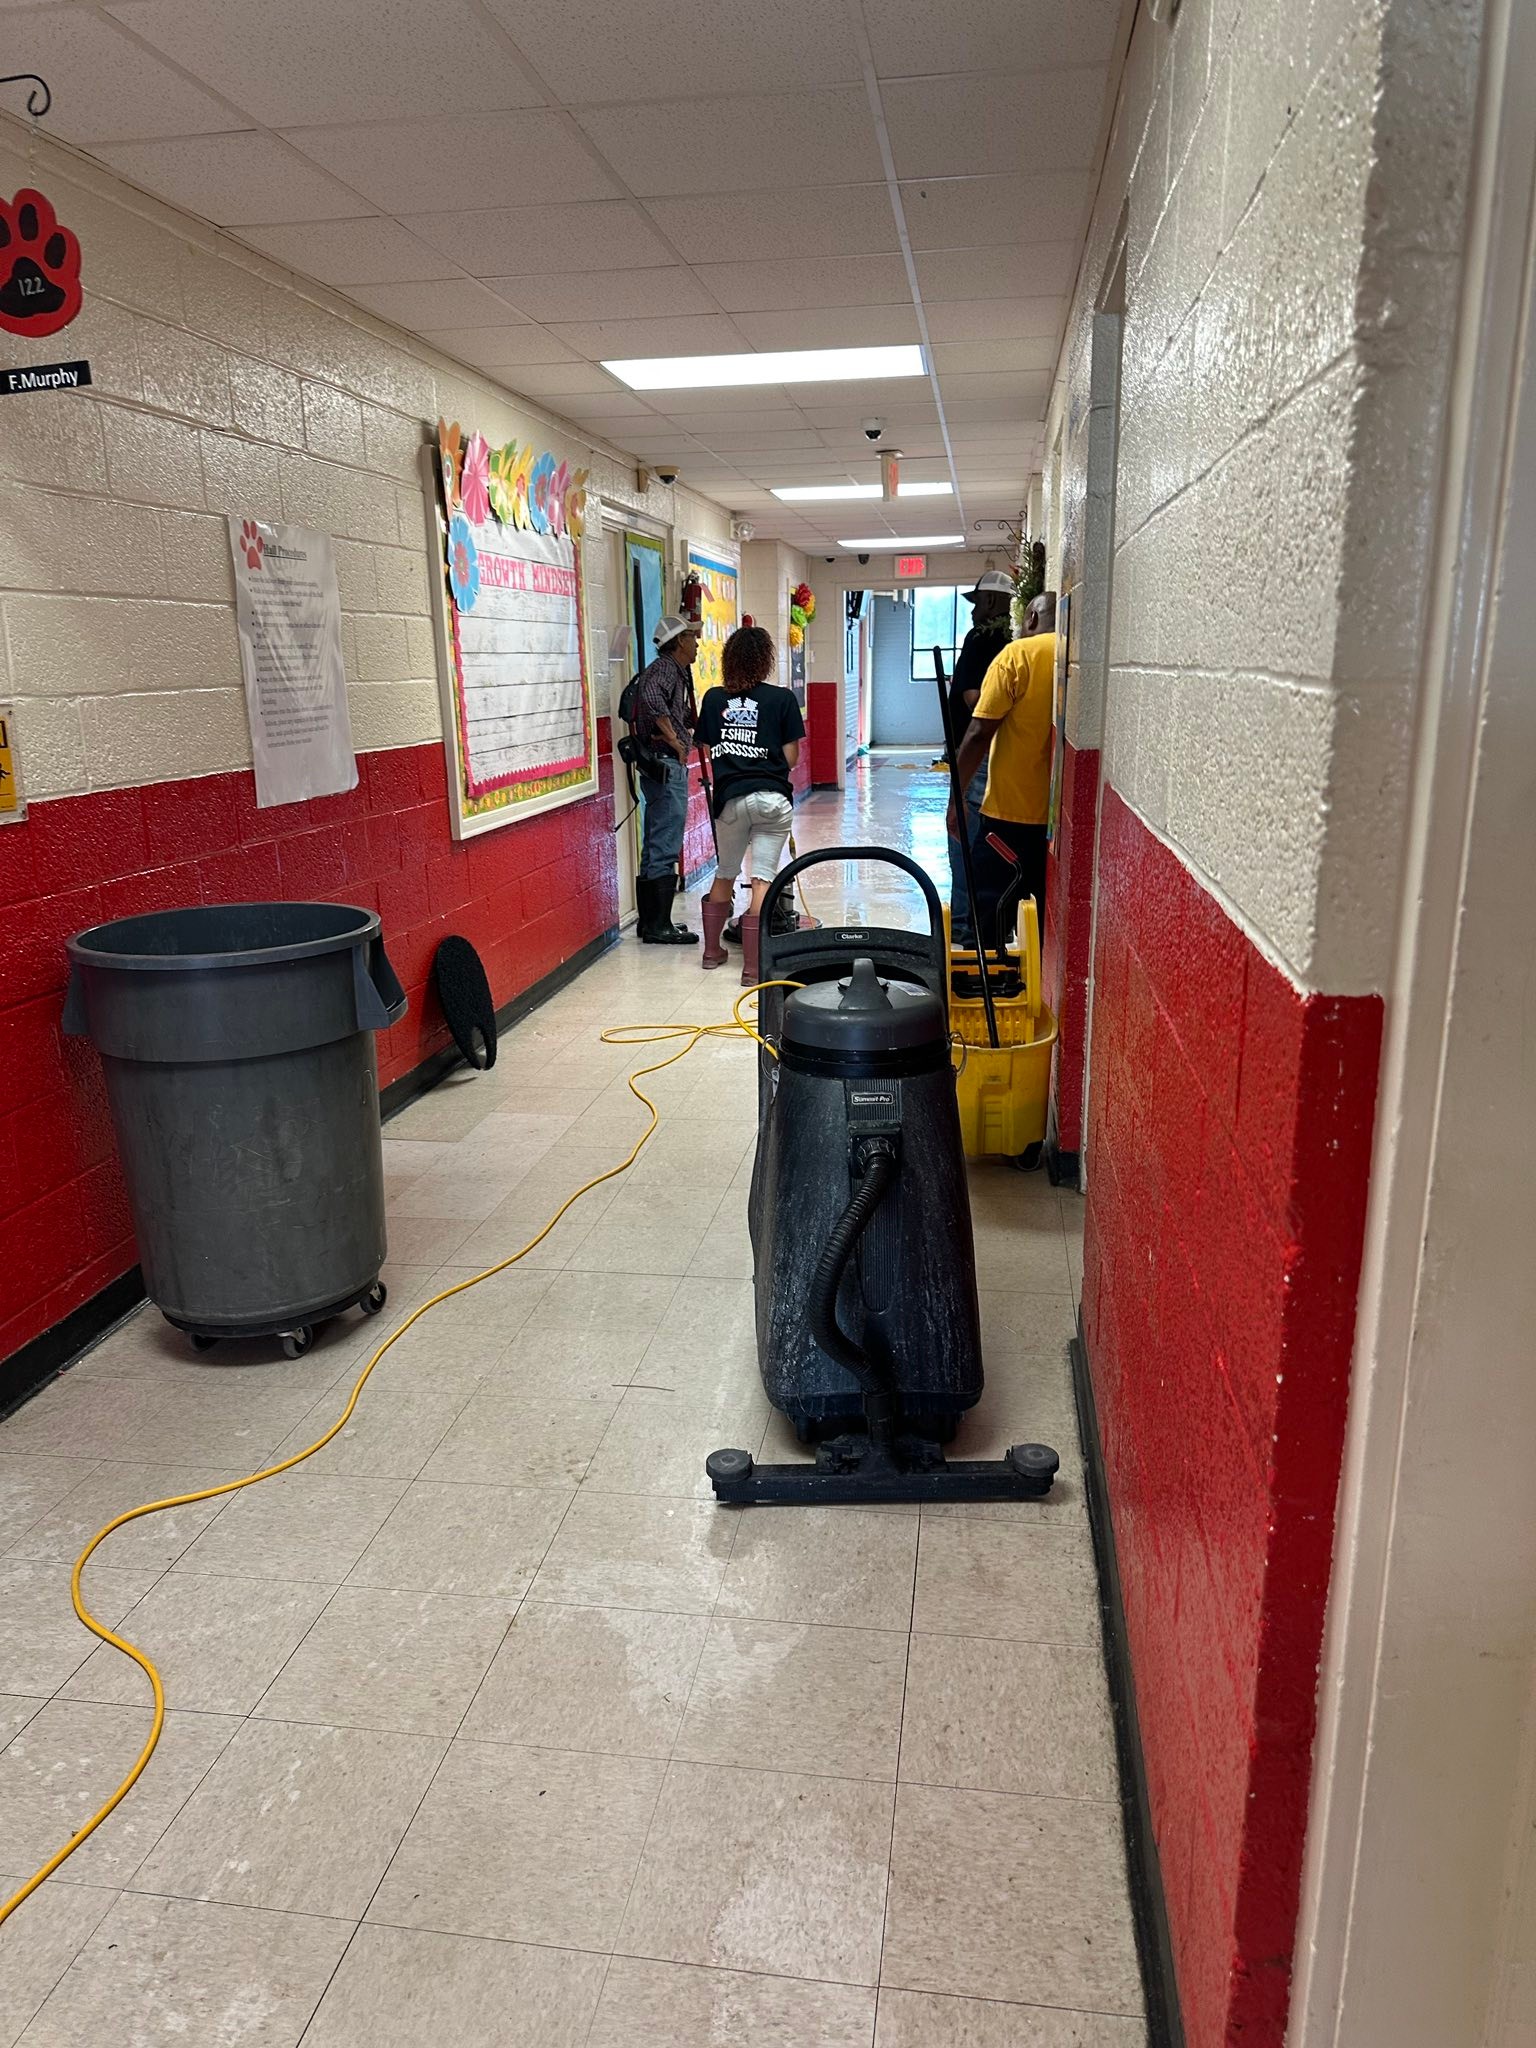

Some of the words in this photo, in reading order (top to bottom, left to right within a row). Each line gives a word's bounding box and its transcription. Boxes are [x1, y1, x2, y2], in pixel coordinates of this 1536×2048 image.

[18, 277, 45, 296] 122
[8, 368, 78, 389] F.Murphy
[478, 550, 527, 590] GROWTH
[530, 562, 577, 598] MINDSET
[720, 728, 758, 744] T-SHIRT
